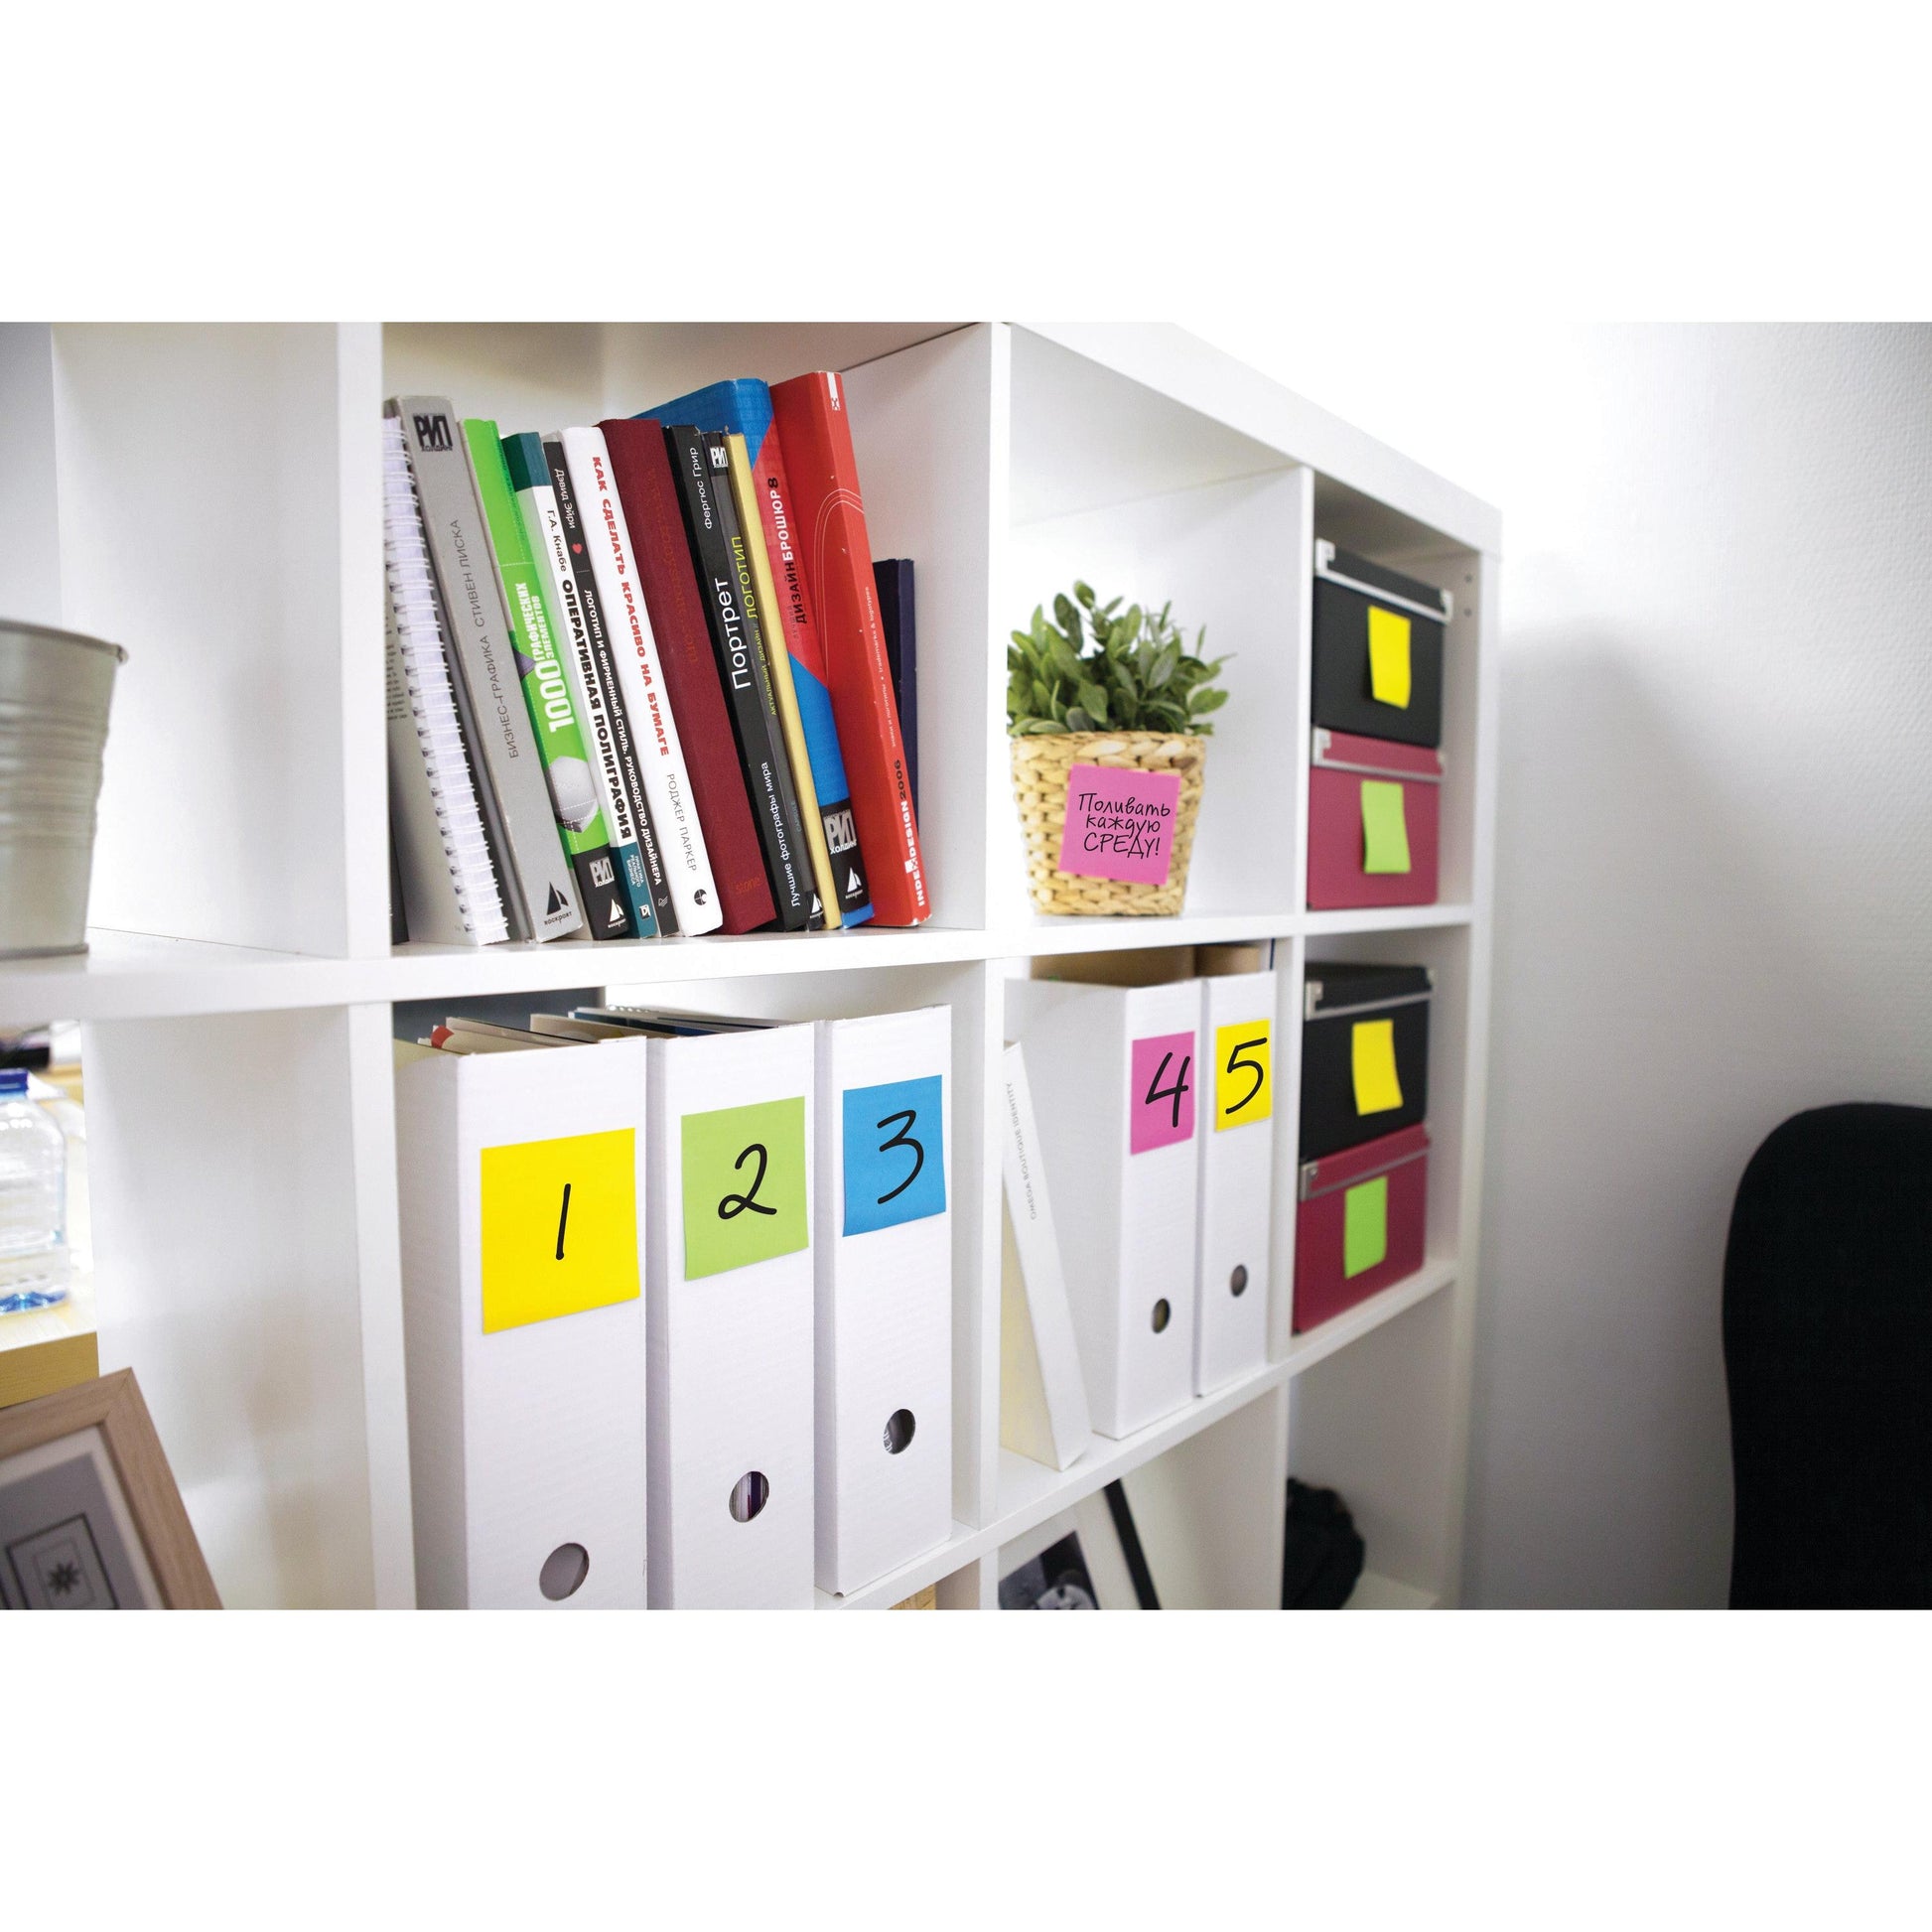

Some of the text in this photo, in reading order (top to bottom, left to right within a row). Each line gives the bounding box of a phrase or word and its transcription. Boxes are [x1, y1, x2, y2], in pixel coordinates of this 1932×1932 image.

[413, 414, 453, 447] РИП
[554, 469, 576, 529] Дэвид Эйри
[690, 447, 713, 529] Фергюс Грир
[547, 509, 567, 572] Г.А. Кнабе
[731, 536, 759, 620] ЛОГОТИП
[450, 519, 519, 759] БИЗНЕС-ГРАФИКА СТИВЕН ЛИСКА
[515, 583, 543, 661] ГРАФИЧЕСКИХ
[531, 596, 555, 658] ЭЛЕМЕНТОВ
[593, 457, 669, 757] КАК СДЕЛАТЬ КРАСИВО НА БУМАГЕ
[715, 578, 752, 690] Портрет
[535, 659, 575, 733] 1000
[562, 580, 632, 839] ОПЕРАТИВНАЯ ПОЛИГРАФИЯ
[584, 590, 603, 637] ЛОГОТИП
[599, 651, 623, 717] ФИРМЕННЫЙ
[624, 757, 648, 825] РУКОВОДСТВО
[640, 828, 662, 886] ДИЗАЙНЕРА
[667, 773, 697, 871] РОДЖЕР ПАРКЕР
[761, 761, 800, 906] Лучшие фотографы мира
[823, 809, 856, 849] РИП
[1079, 793, 1171, 816] Поливать
[1086, 814, 1161, 839] каждую
[1084, 832, 1161, 860] СРЕДУ!
[1006, 1082, 1020, 1128] IDENTITY
[1146, 1052, 1190, 1127] 4
[1226, 1037, 1267, 1114] 5
[719, 1144, 776, 1219] 2
[878, 1110, 923, 1203] 3
[1015, 1129, 1030, 1179] BOUTIQUE
[556, 1184, 571, 1260] 1
